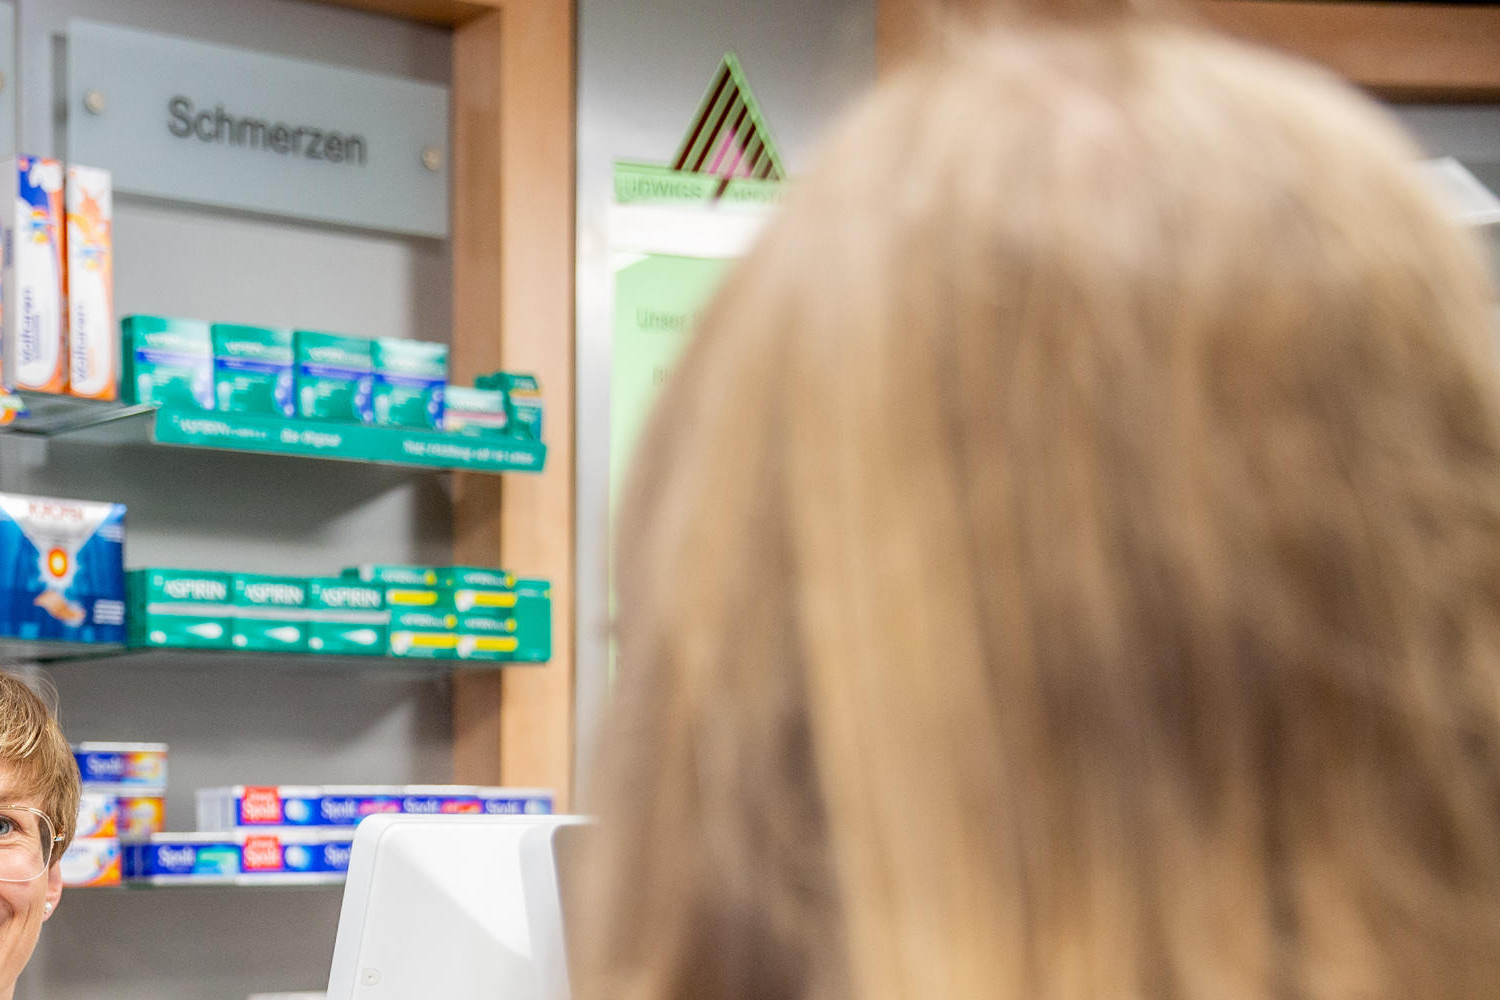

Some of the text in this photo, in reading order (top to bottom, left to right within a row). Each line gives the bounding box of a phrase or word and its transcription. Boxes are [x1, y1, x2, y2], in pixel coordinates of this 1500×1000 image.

[167, 95, 368, 168] Schmerzen
[164, 580, 227, 601] ASPIRIN
[244, 581, 305, 605] ASPIRIN
[320, 586, 382, 608] ASPIRIN
